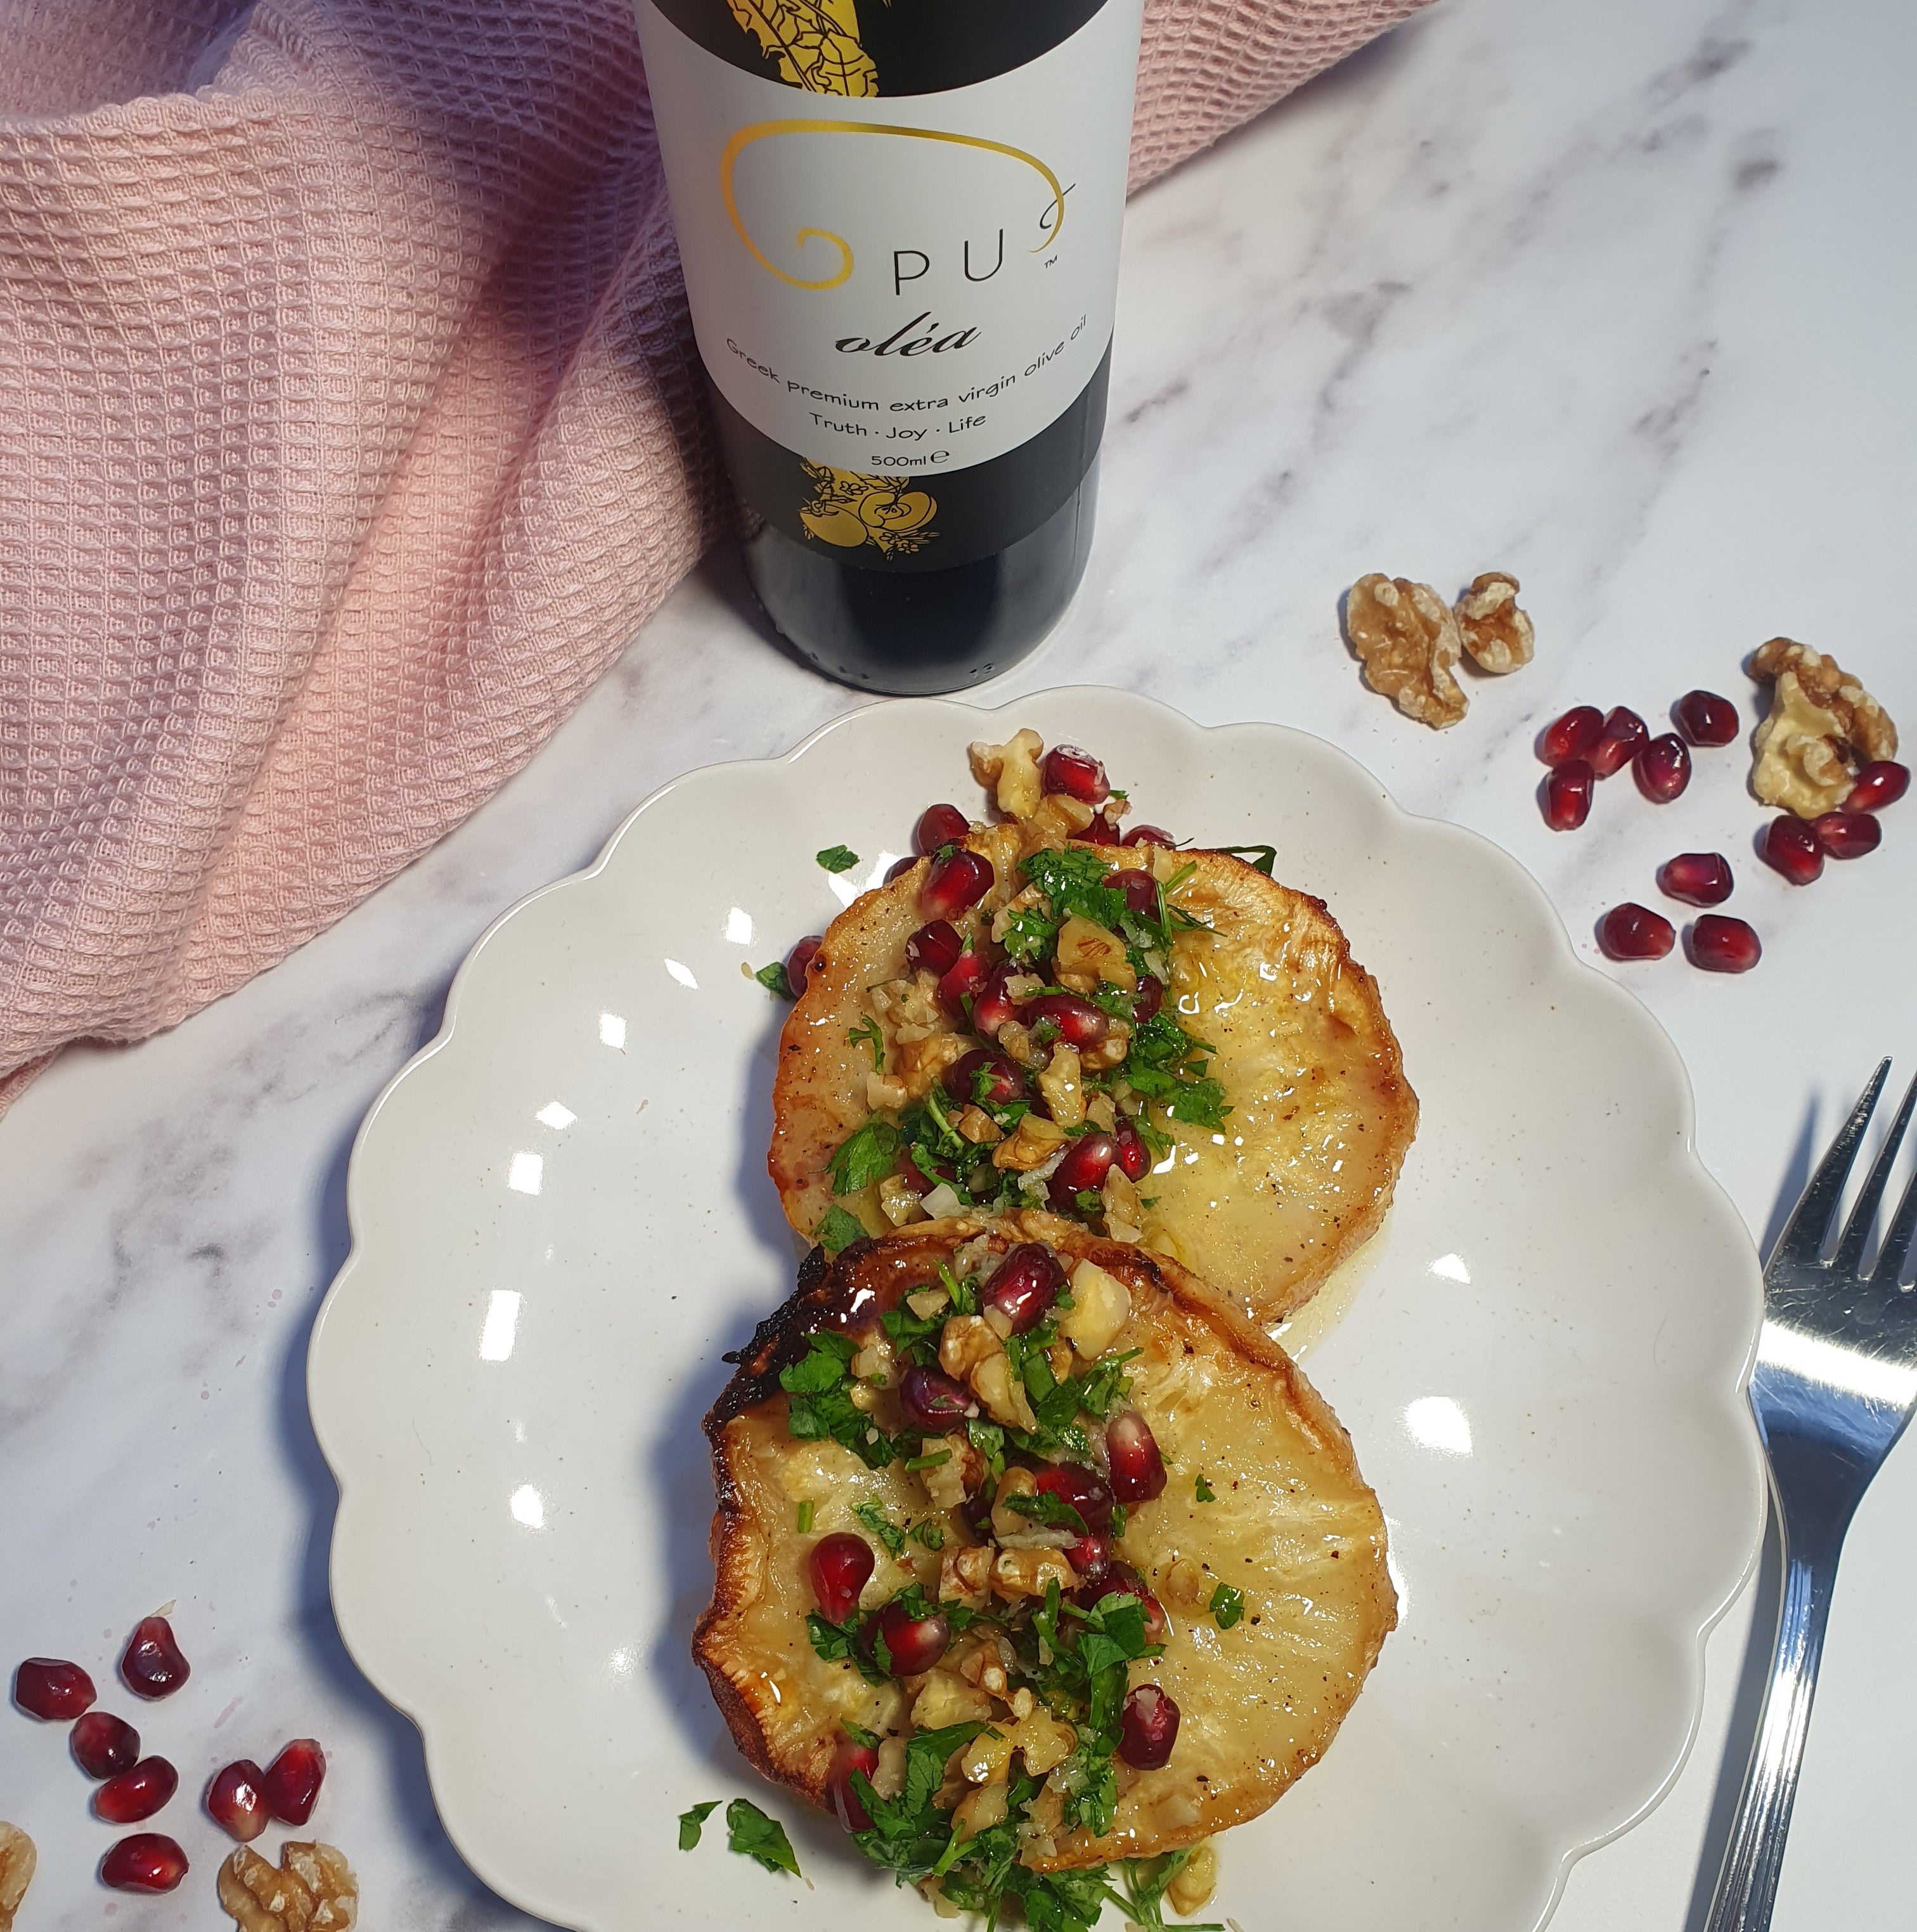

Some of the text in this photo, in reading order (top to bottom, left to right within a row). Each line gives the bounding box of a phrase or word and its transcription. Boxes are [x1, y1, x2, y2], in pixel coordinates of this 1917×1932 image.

[835, 311, 982, 357] oléa
[726, 314, 1087, 411] Greek premium extra virgin olive oil
[809, 412, 986, 441] Truth Joy Life
